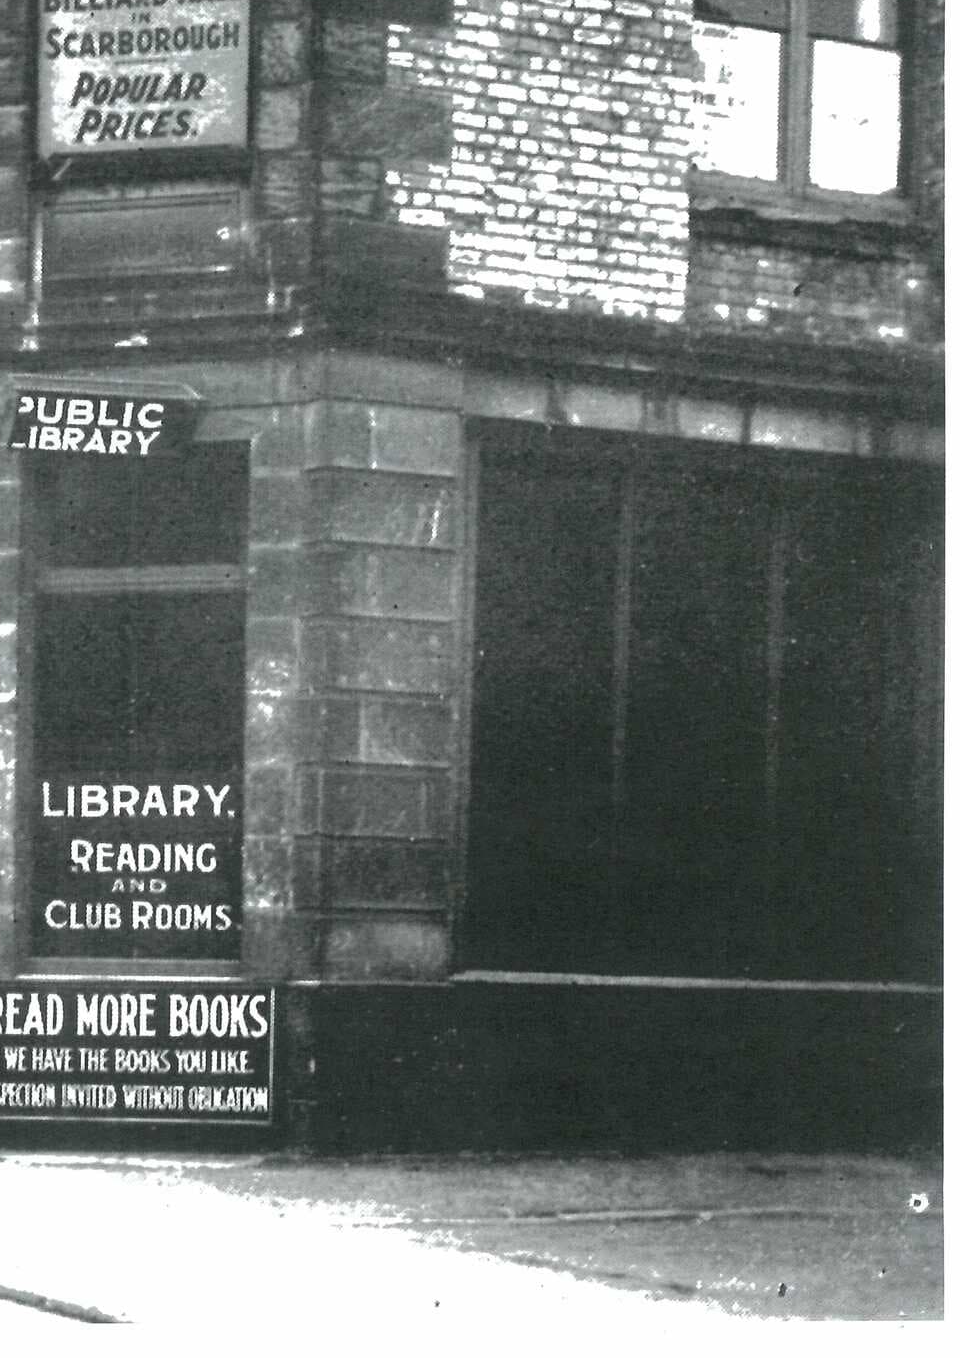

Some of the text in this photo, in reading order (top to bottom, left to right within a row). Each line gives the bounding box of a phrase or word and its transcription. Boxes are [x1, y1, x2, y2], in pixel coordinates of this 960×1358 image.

[46, 22, 240, 60] SCARBOROUGH
[70, 72, 208, 108] POPULAR
[74, 109, 199, 143] PRICES.
[42, 781, 235, 818] LIBRARY.
[70, 839, 217, 873] READING
[111, 878, 167, 893] AND
[45, 899, 122, 929] CLUB
[77, 994, 156, 1037] MORE
[169, 994, 268, 1038] BOOKS
[4, 1046, 26, 1072] WE
[32, 1046, 73, 1072] HAVE
[79, 1048, 108, 1073] THE
[115, 1048, 171, 1074] BOOKS
[175, 1049, 206, 1074] YOU
[122, 1084, 184, 1111] WITHOUT
[188, 1085, 268, 1113] OBLIGATION
